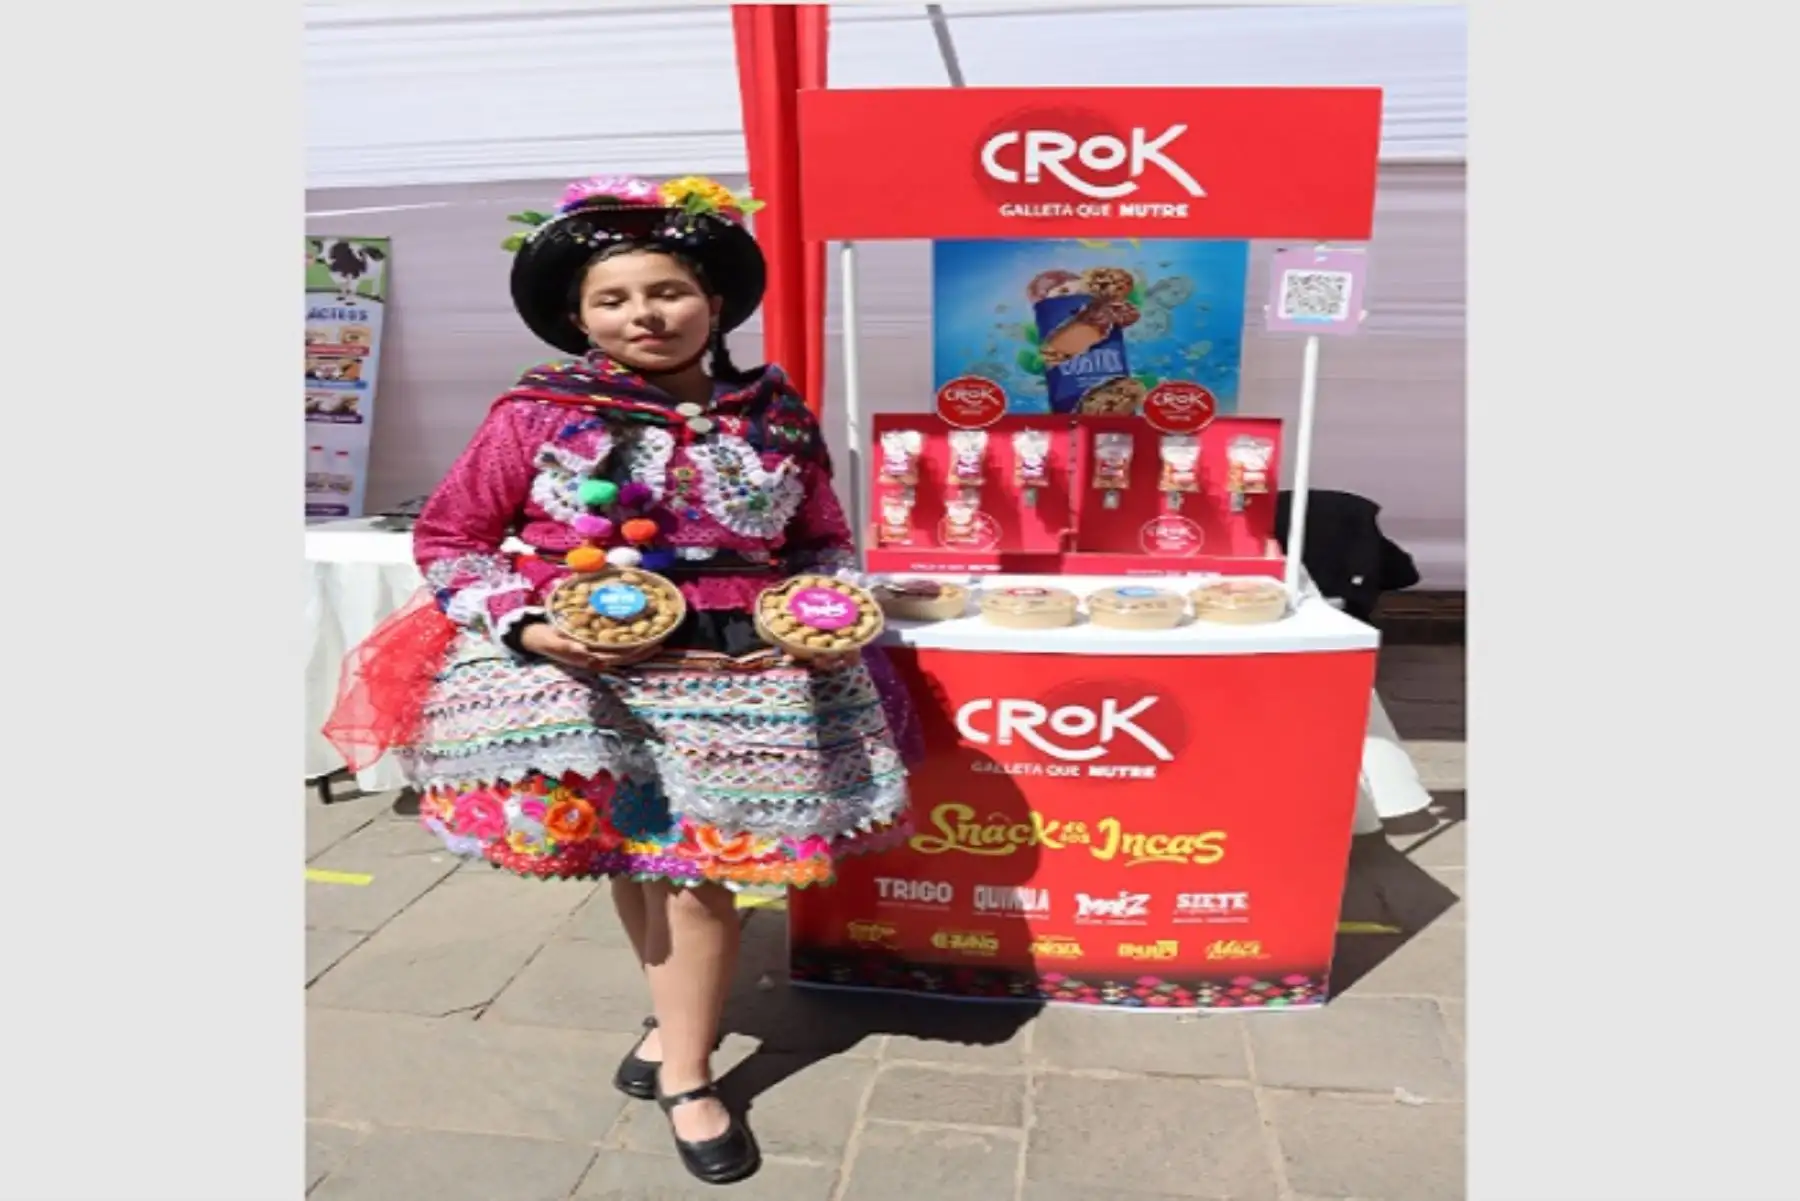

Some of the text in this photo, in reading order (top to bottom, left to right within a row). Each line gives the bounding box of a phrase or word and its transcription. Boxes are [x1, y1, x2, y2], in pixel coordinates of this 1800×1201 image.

[1000, 203, 1188, 218] GALLETA QUE NUTRE
[971, 761, 1156, 778] GALLETA QUE NUTRE
[1090, 817, 1227, 867] Incas
[875, 877, 953, 903] TRIGO
[1176, 892, 1248, 909] SIETE
